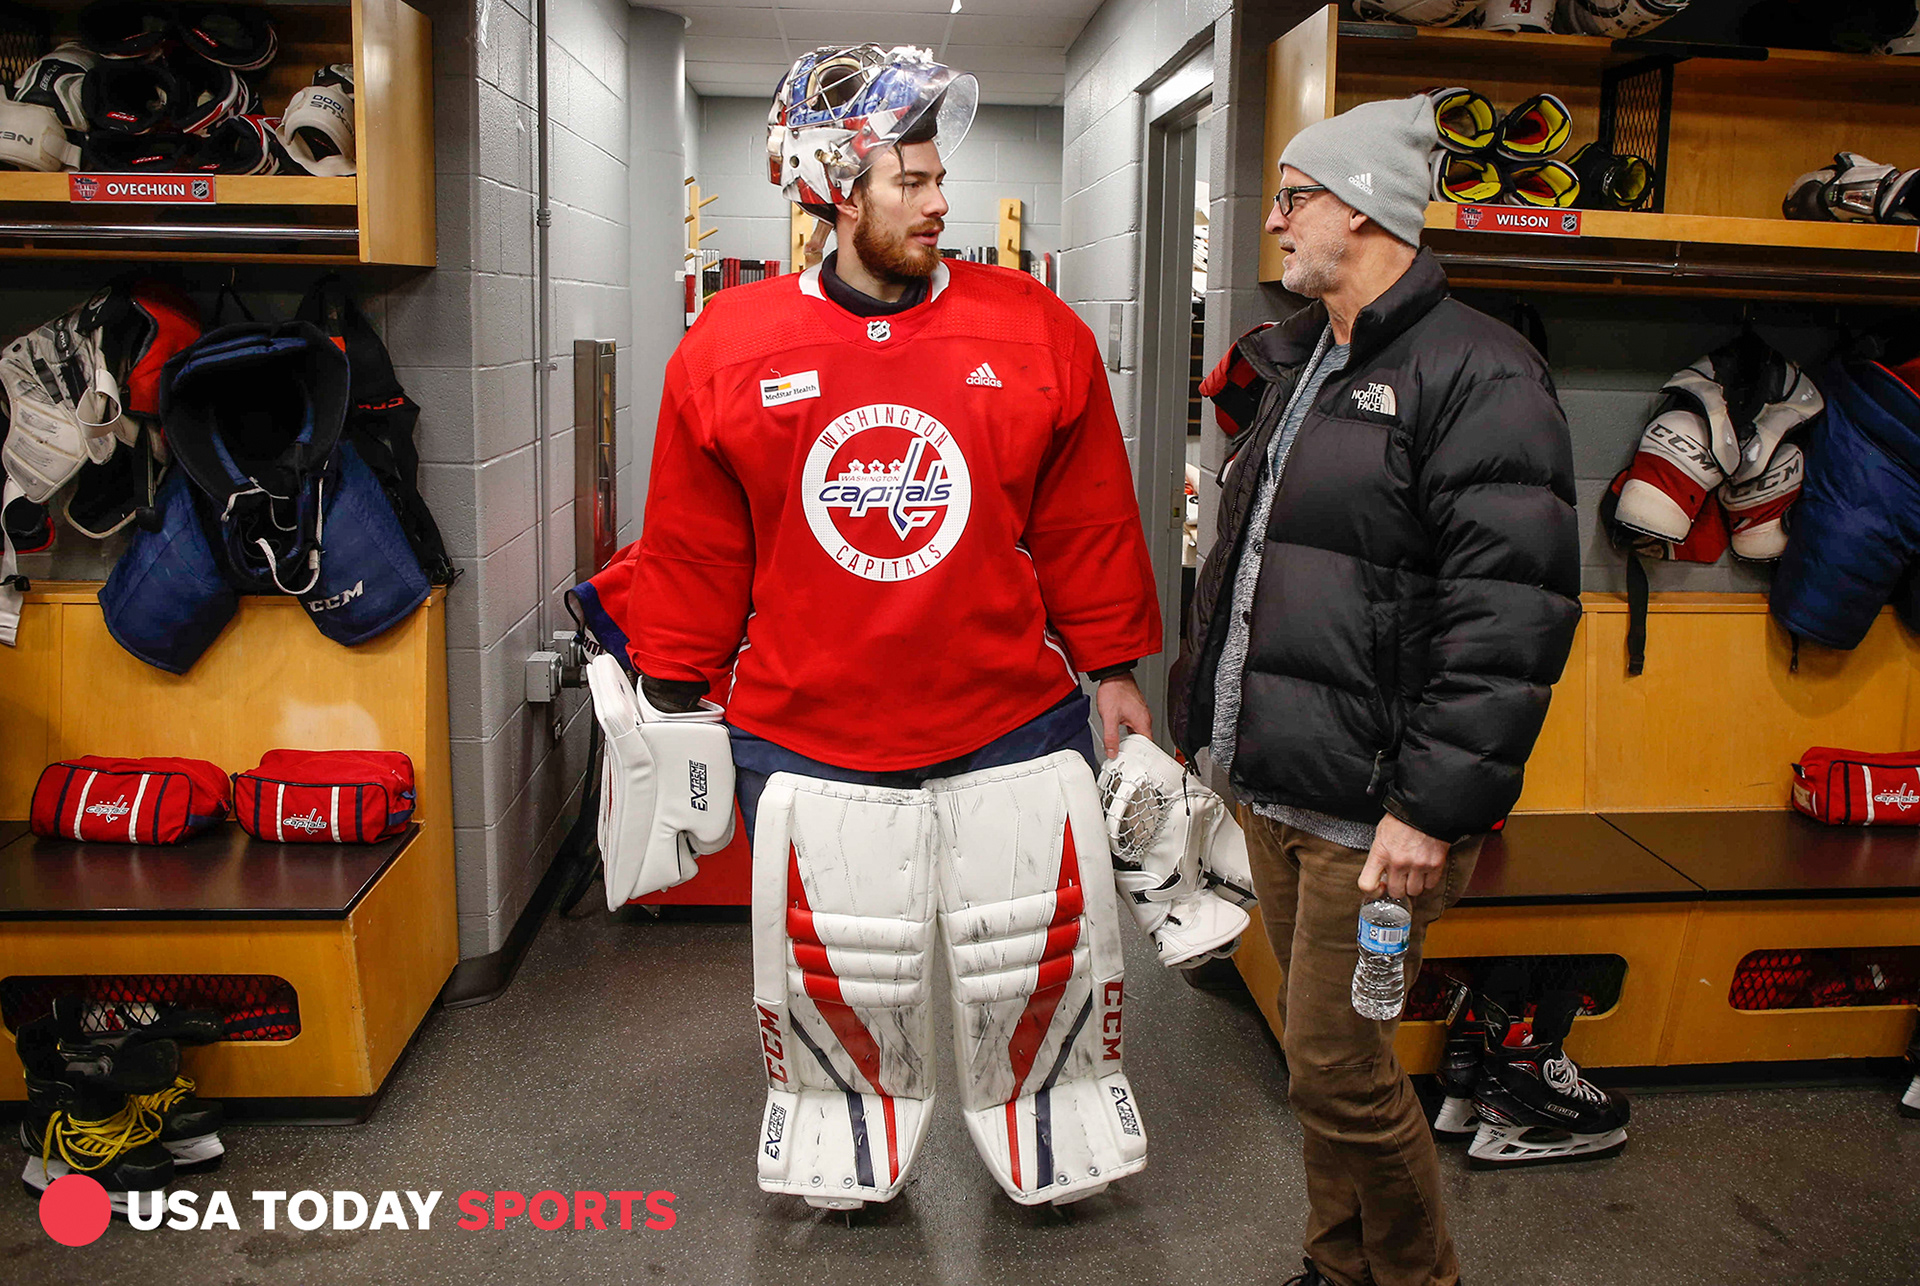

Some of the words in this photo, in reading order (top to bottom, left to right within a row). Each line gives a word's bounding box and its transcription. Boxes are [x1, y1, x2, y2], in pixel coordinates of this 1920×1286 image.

[0, 130, 34, 146] NE
[106, 183, 186, 196] OVECHKIN
[1349, 176, 1373, 195] adidas
[1496, 214, 1549, 228] WILSON
[965, 377, 1003, 388] adidas
[1368, 382, 1385, 394] THE
[765, 391, 792, 401] MedStar
[793, 384, 817, 395] Health
[1351, 389, 1381, 404] NORTH
[1357, 400, 1381, 412] FACE
[819, 406, 949, 450] WASHINGTON
[1650, 423, 1719, 472] CCM
[818, 443, 952, 532] capitals
[836, 544, 942, 579] CAPITALS
[307, 580, 364, 612] CCM
[1102, 980, 1124, 1060] CCM
[756, 1003, 789, 1084] CCM
